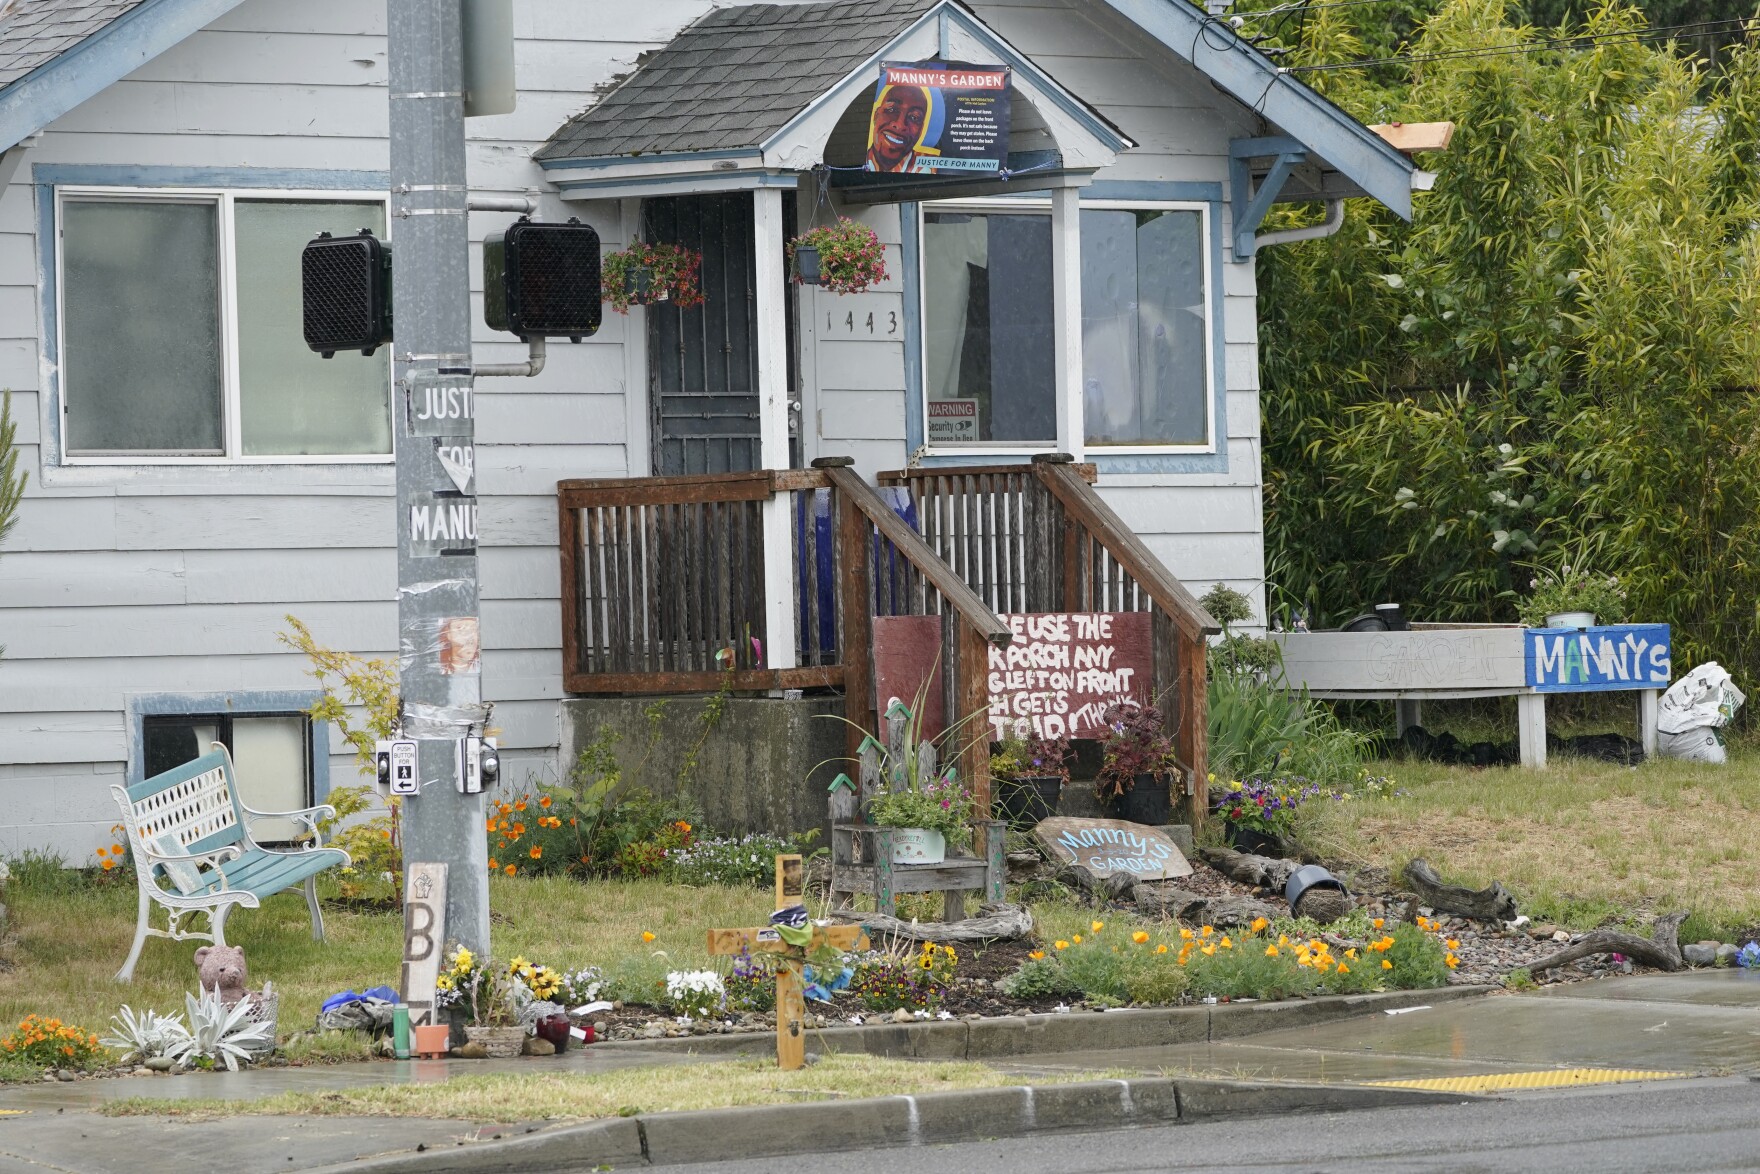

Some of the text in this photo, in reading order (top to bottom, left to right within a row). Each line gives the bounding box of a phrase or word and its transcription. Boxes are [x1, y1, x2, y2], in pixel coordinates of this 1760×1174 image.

[890, 72, 1002, 87] MANNY'S GARDEN
[916, 158, 997, 169] JUSTICE FOR MANNY
[827, 311, 897, 334] 1443
[1028, 614, 1070, 642] USE
[1072, 614, 1114, 641] THE
[1006, 642, 1070, 670] PORCH
[1074, 645, 1115, 670] ANY
[1534, 632, 1672, 684] MANNYS
[1076, 668, 1134, 695] FRONT
[1013, 690, 1068, 716] GETS
[1057, 828, 1172, 864] Manny's
[1090, 856, 1164, 874] GARDEN
